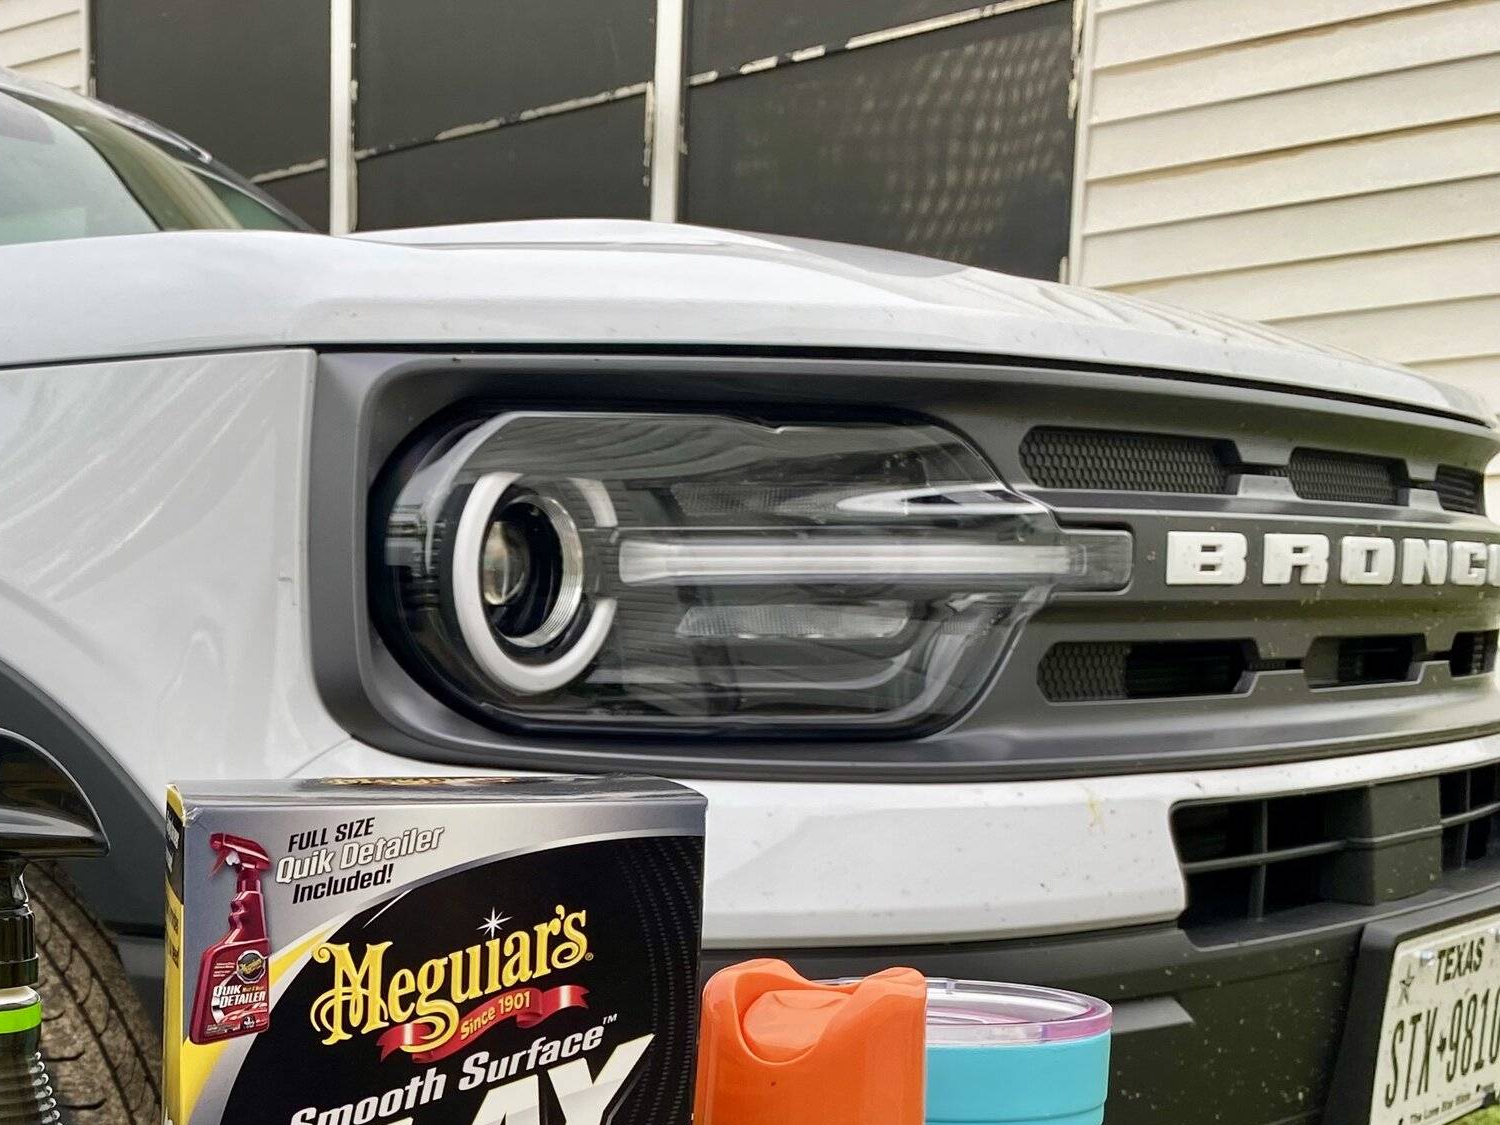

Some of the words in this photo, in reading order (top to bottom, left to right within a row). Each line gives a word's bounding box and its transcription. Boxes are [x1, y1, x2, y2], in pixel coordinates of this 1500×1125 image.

[276, 849, 336, 884] Quik
[340, 827, 445, 870] Detailer
[288, 828, 328, 852] FULL
[335, 817, 375, 842] SIZE
[292, 864, 394, 904] Included!
[310, 904, 587, 1053] Meguiar's
[1436, 937, 1485, 985] TEXAS
[214, 985, 241, 996] QUIK
[460, 1010, 496, 1040] Since
[499, 992, 530, 1014] 1901
[460, 1026, 604, 1091] Surface
